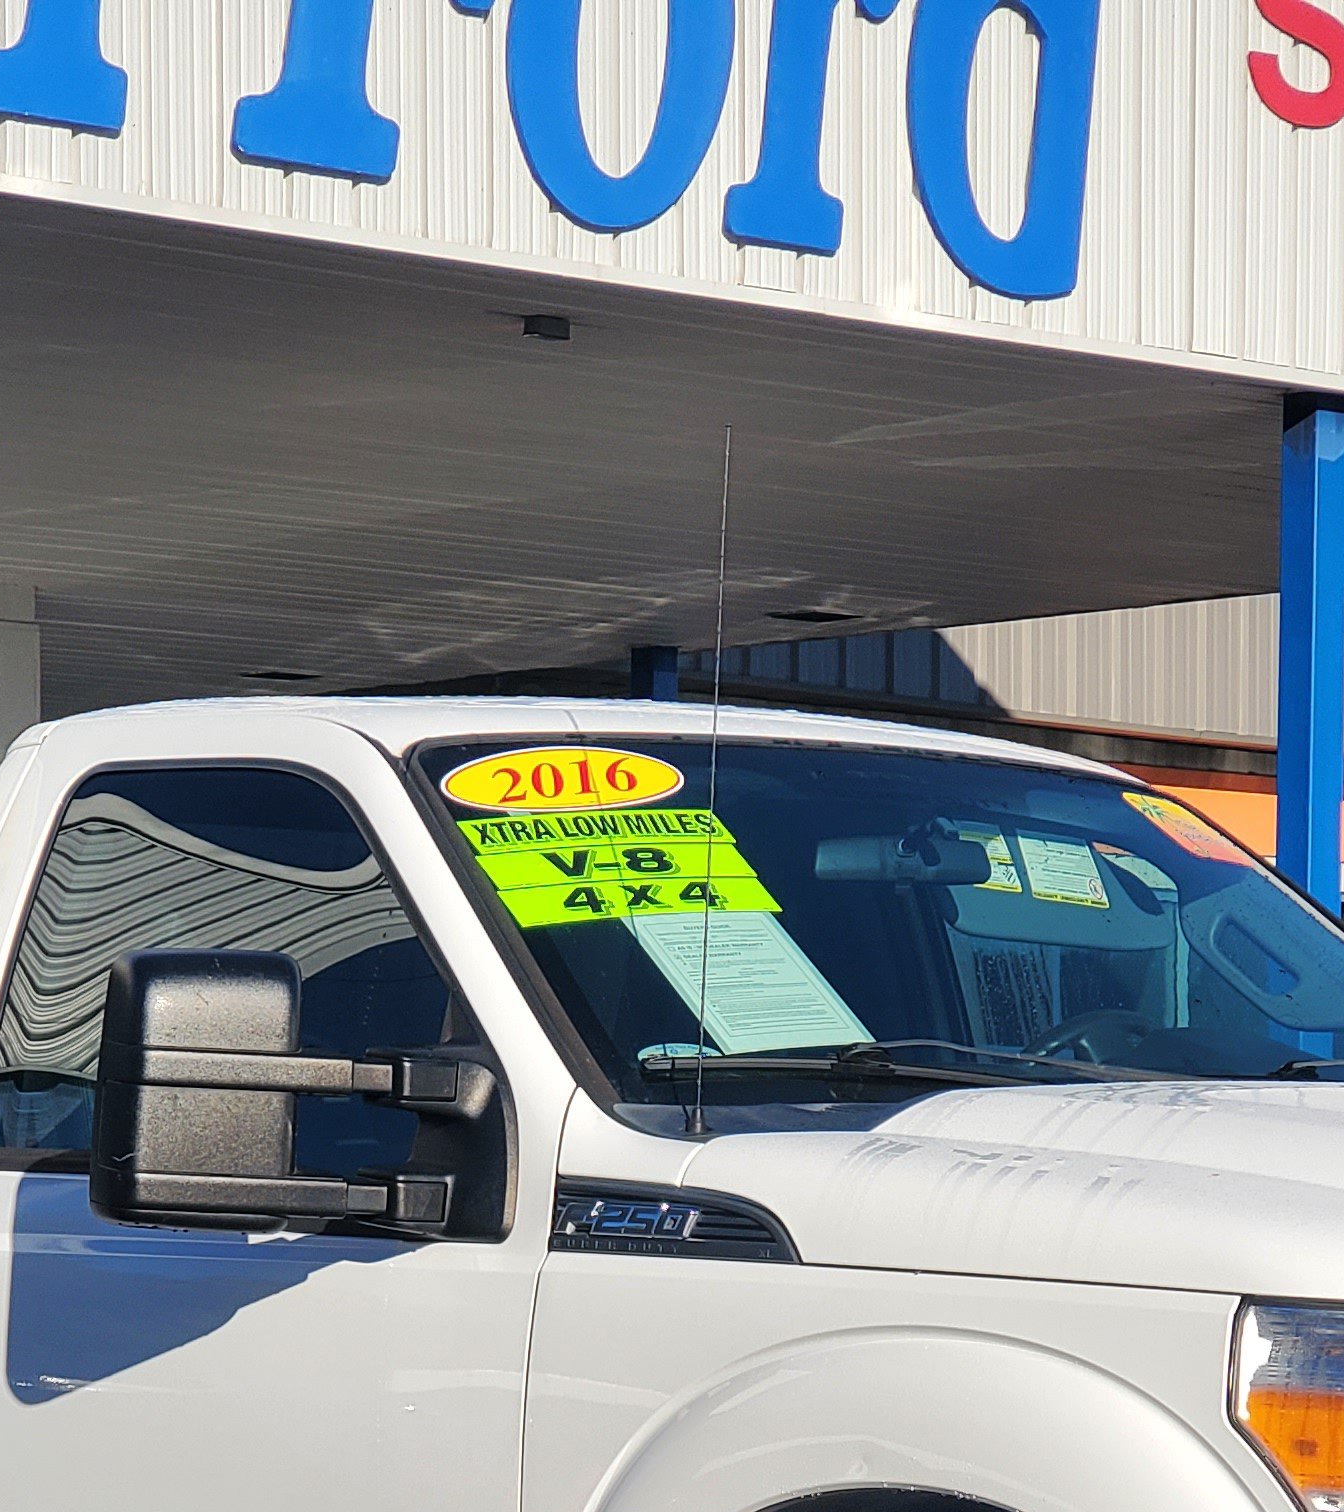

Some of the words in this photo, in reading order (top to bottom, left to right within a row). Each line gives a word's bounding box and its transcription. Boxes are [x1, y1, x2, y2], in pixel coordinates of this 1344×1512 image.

[492, 757, 638, 803] 2016
[470, 817, 557, 846] XTRA
[556, 814, 623, 840] LOW
[622, 812, 720, 838] MILES
[540, 848, 677, 878] V-8
